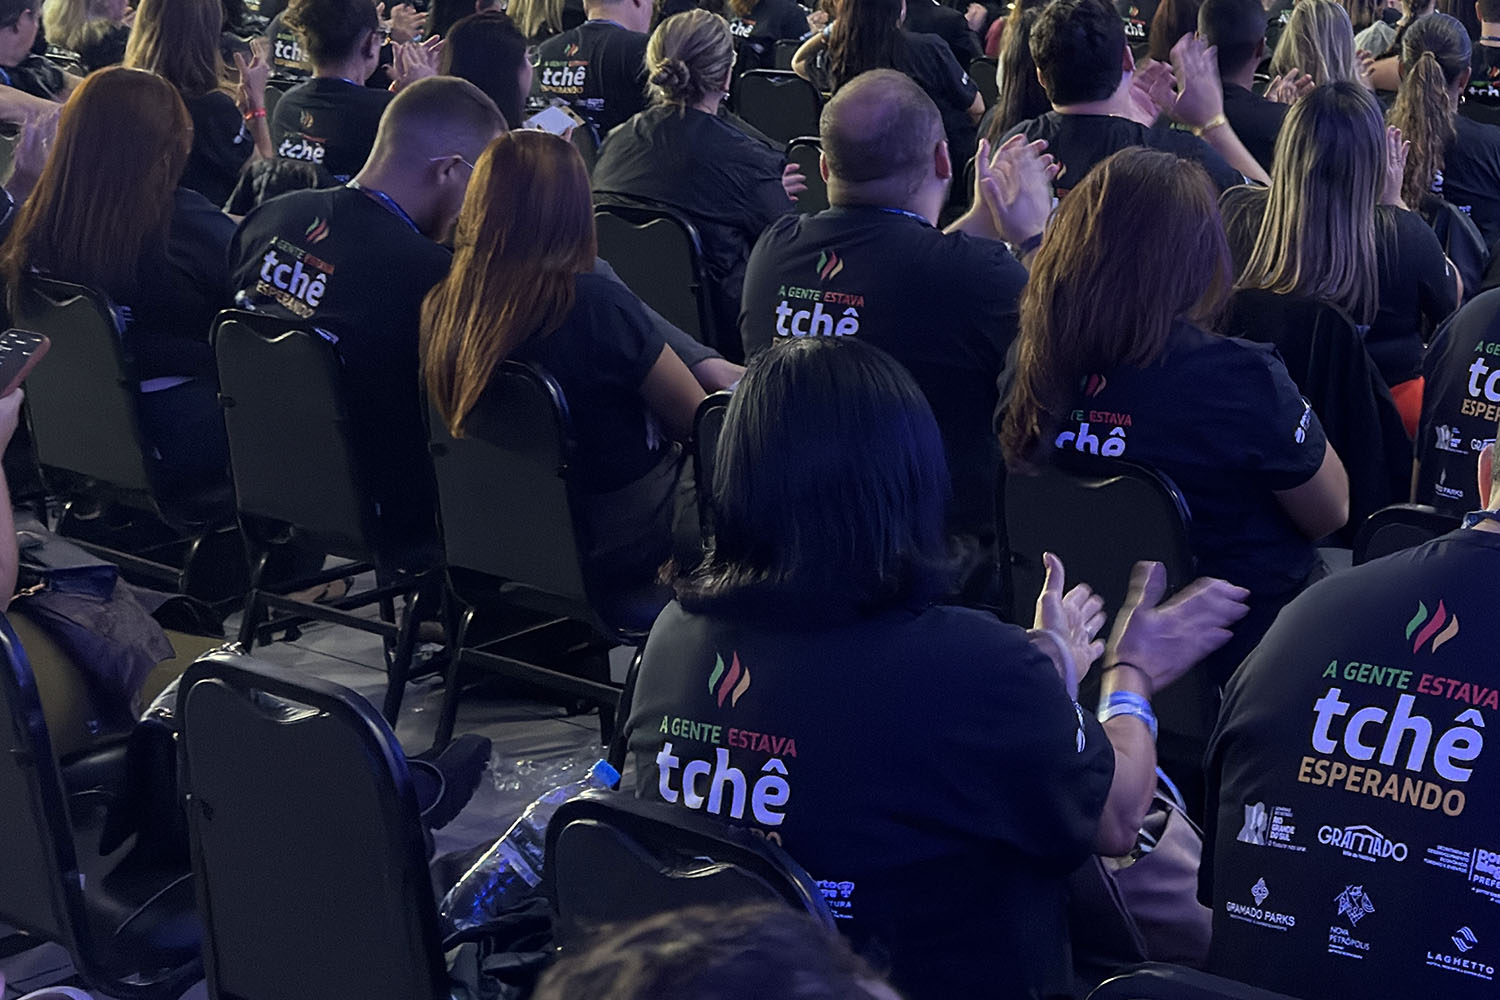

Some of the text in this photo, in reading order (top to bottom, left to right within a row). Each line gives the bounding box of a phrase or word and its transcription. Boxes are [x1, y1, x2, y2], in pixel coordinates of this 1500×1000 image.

[730, 20, 754, 38] chê
[542, 66, 586, 86] tchê
[260, 250, 327, 307] tchê
[777, 285, 865, 307] A GENTE ESTAVA
[775, 300, 860, 337] tchê
[1474, 340, 1484, 353] A
[1089, 410, 1132, 426] ESTAVA
[1322, 659, 1499, 711] A GENTE ESTAVA
[659, 715, 798, 758] A GENTE ESTAVA
[1311, 687, 1486, 782] tchê
[656, 741, 791, 826] tchê
[1297, 756, 1467, 817] ESPERANDO
[1317, 825, 1409, 862] GRAMADO
[1226, 901, 1264, 920] GRAMADO
[1264, 911, 1296, 927] PARKS
[1329, 926, 1349, 936] NOVA
[1427, 951, 1495, 975] LAGHETTO
